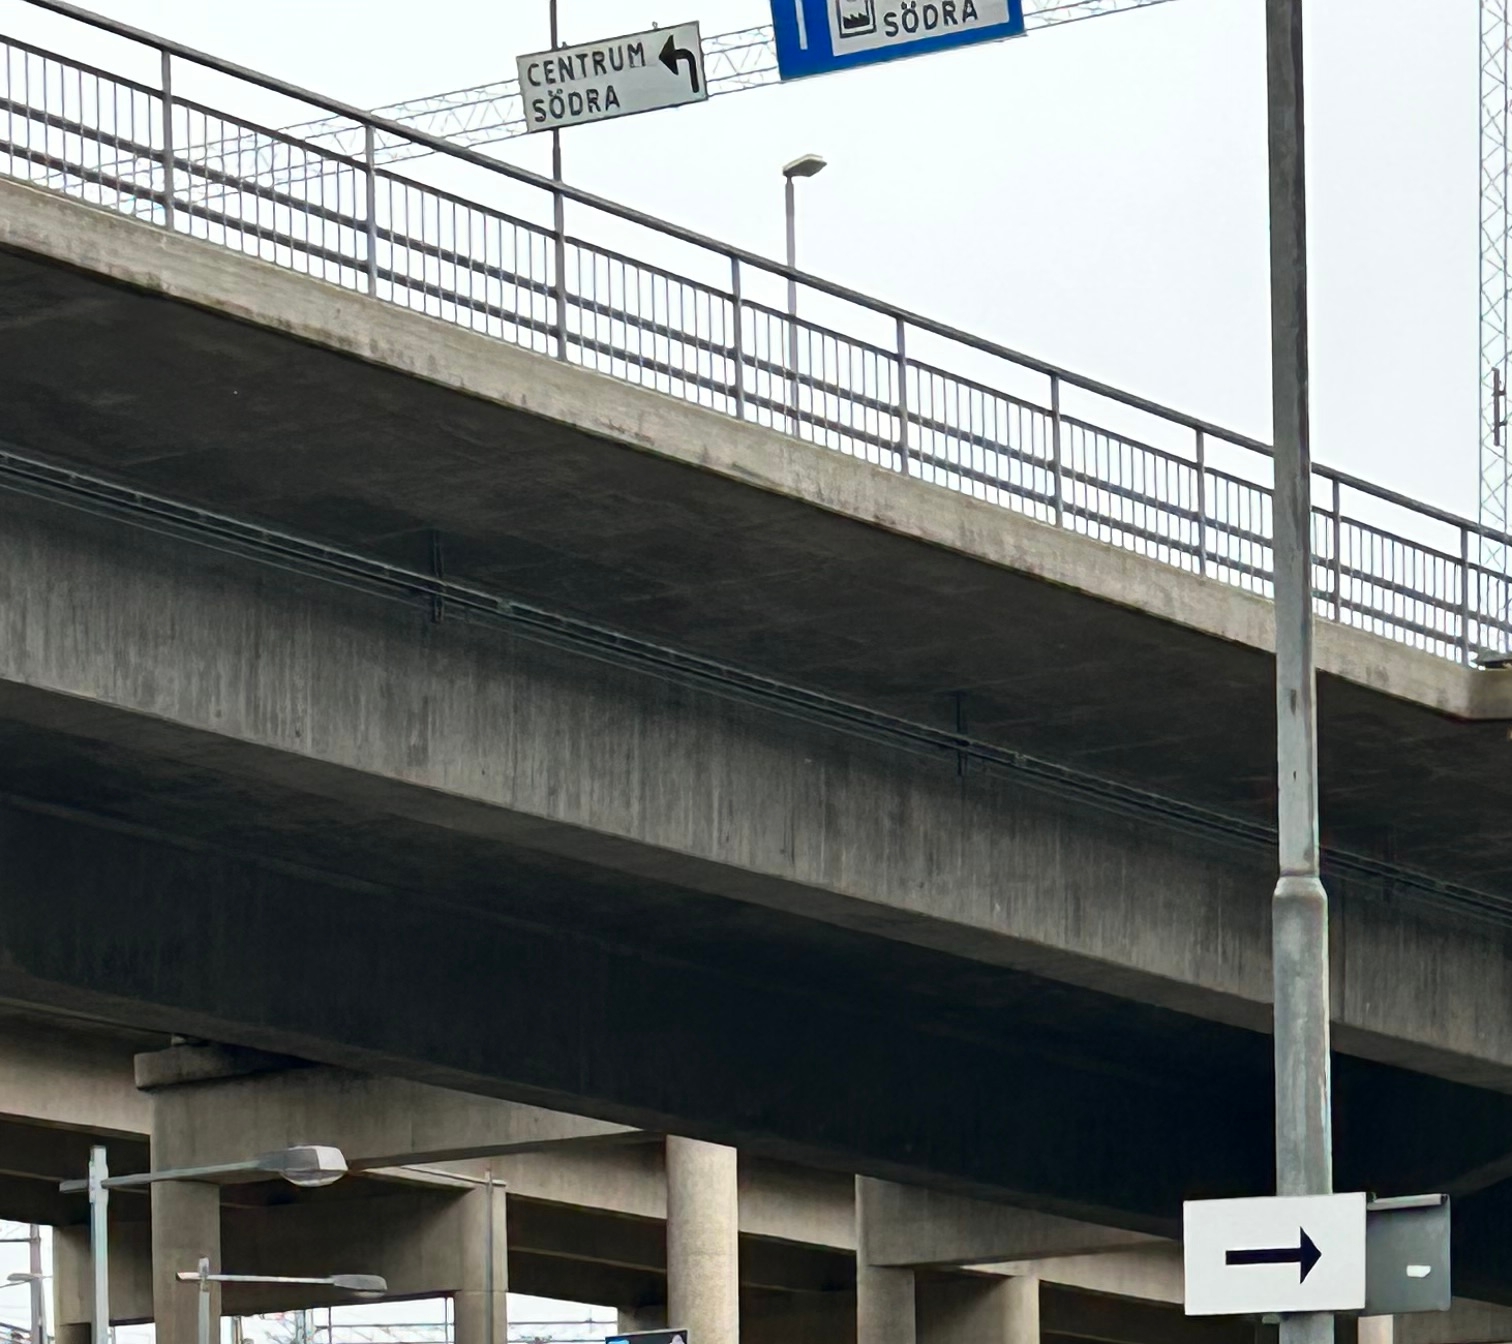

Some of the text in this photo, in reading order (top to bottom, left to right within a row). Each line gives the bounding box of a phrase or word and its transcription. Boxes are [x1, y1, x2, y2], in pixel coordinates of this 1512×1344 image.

[884, 0, 979, 37] SÖDRA
[527, 42, 646, 86] CENTRUM
[532, 85, 620, 122] SÖDRA
